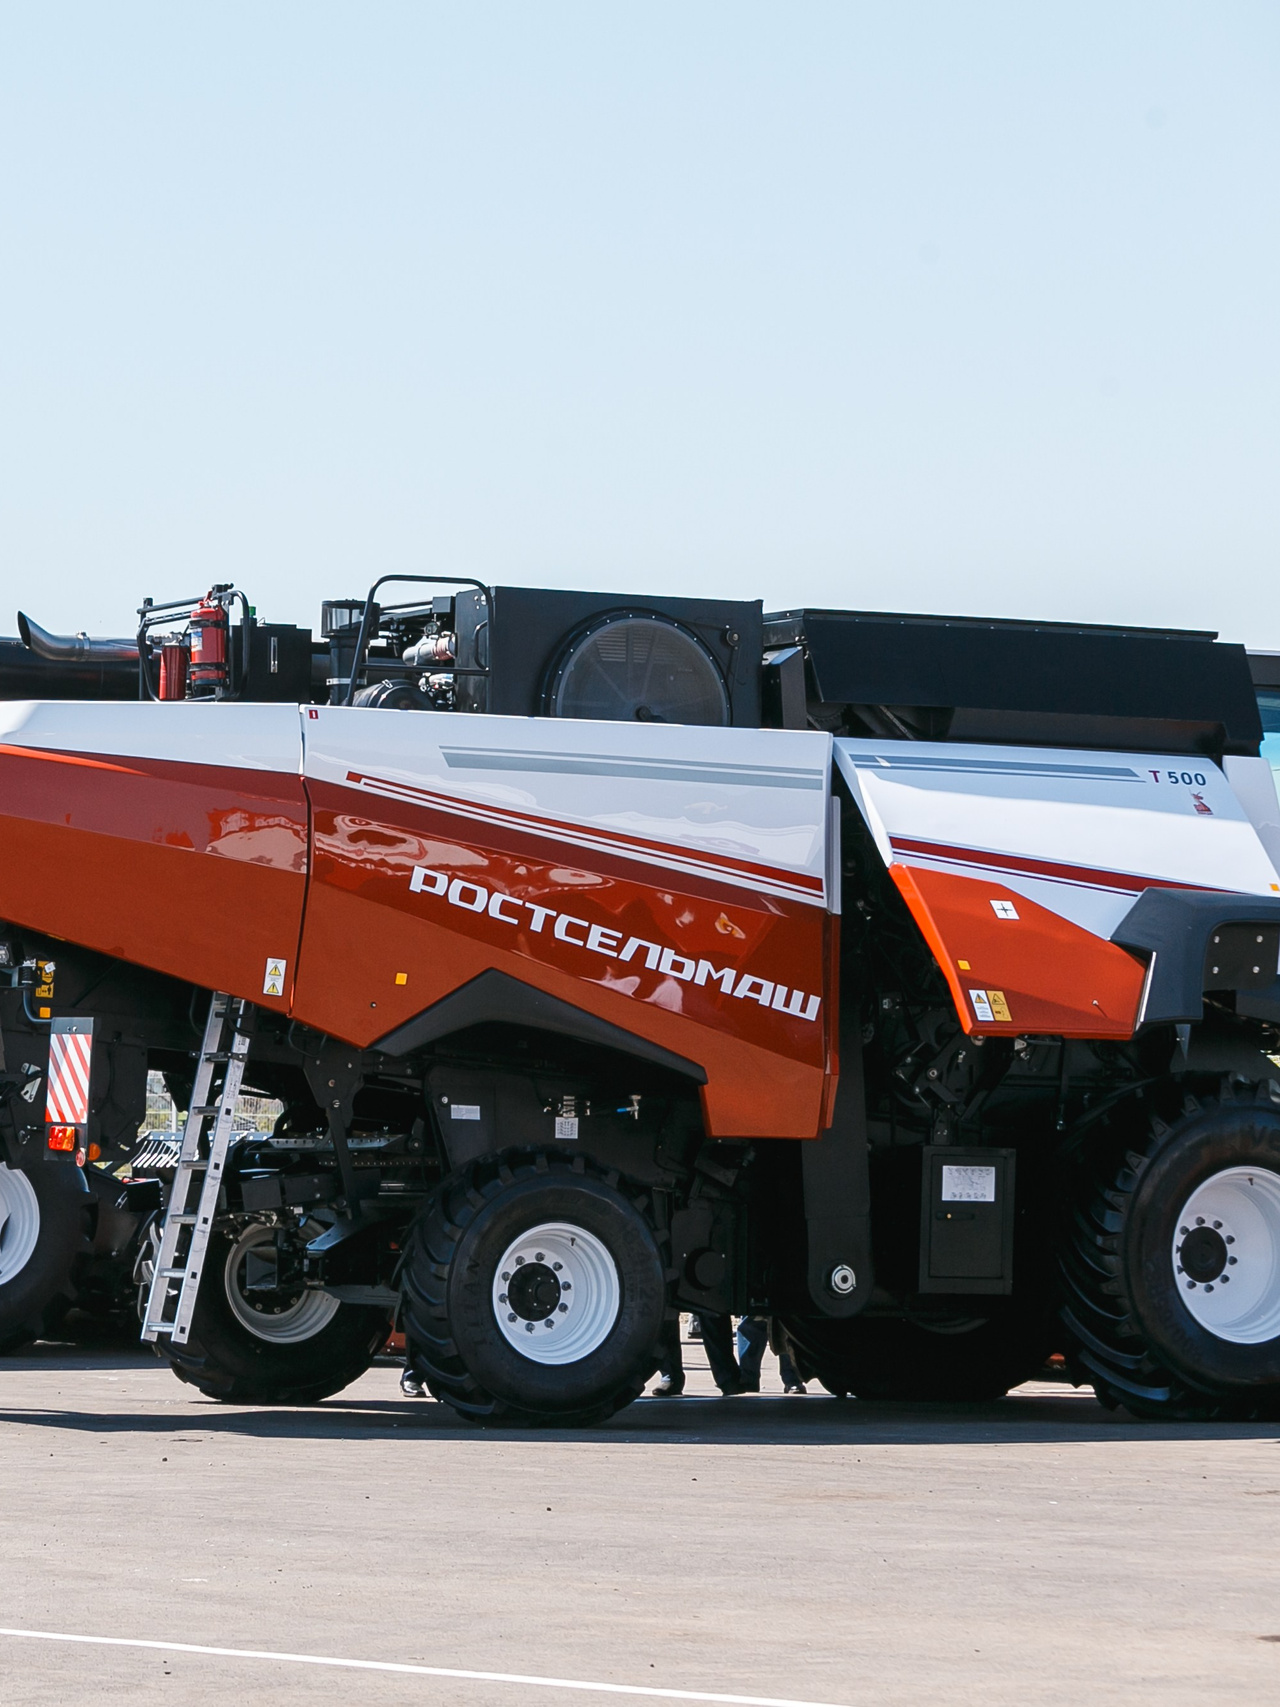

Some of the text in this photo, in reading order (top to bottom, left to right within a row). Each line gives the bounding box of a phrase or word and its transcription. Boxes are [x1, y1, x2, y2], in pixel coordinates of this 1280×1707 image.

[1148, 770, 1207, 786] T 500
[408, 864, 822, 1022] РОСТСЕЛЬМАШ
